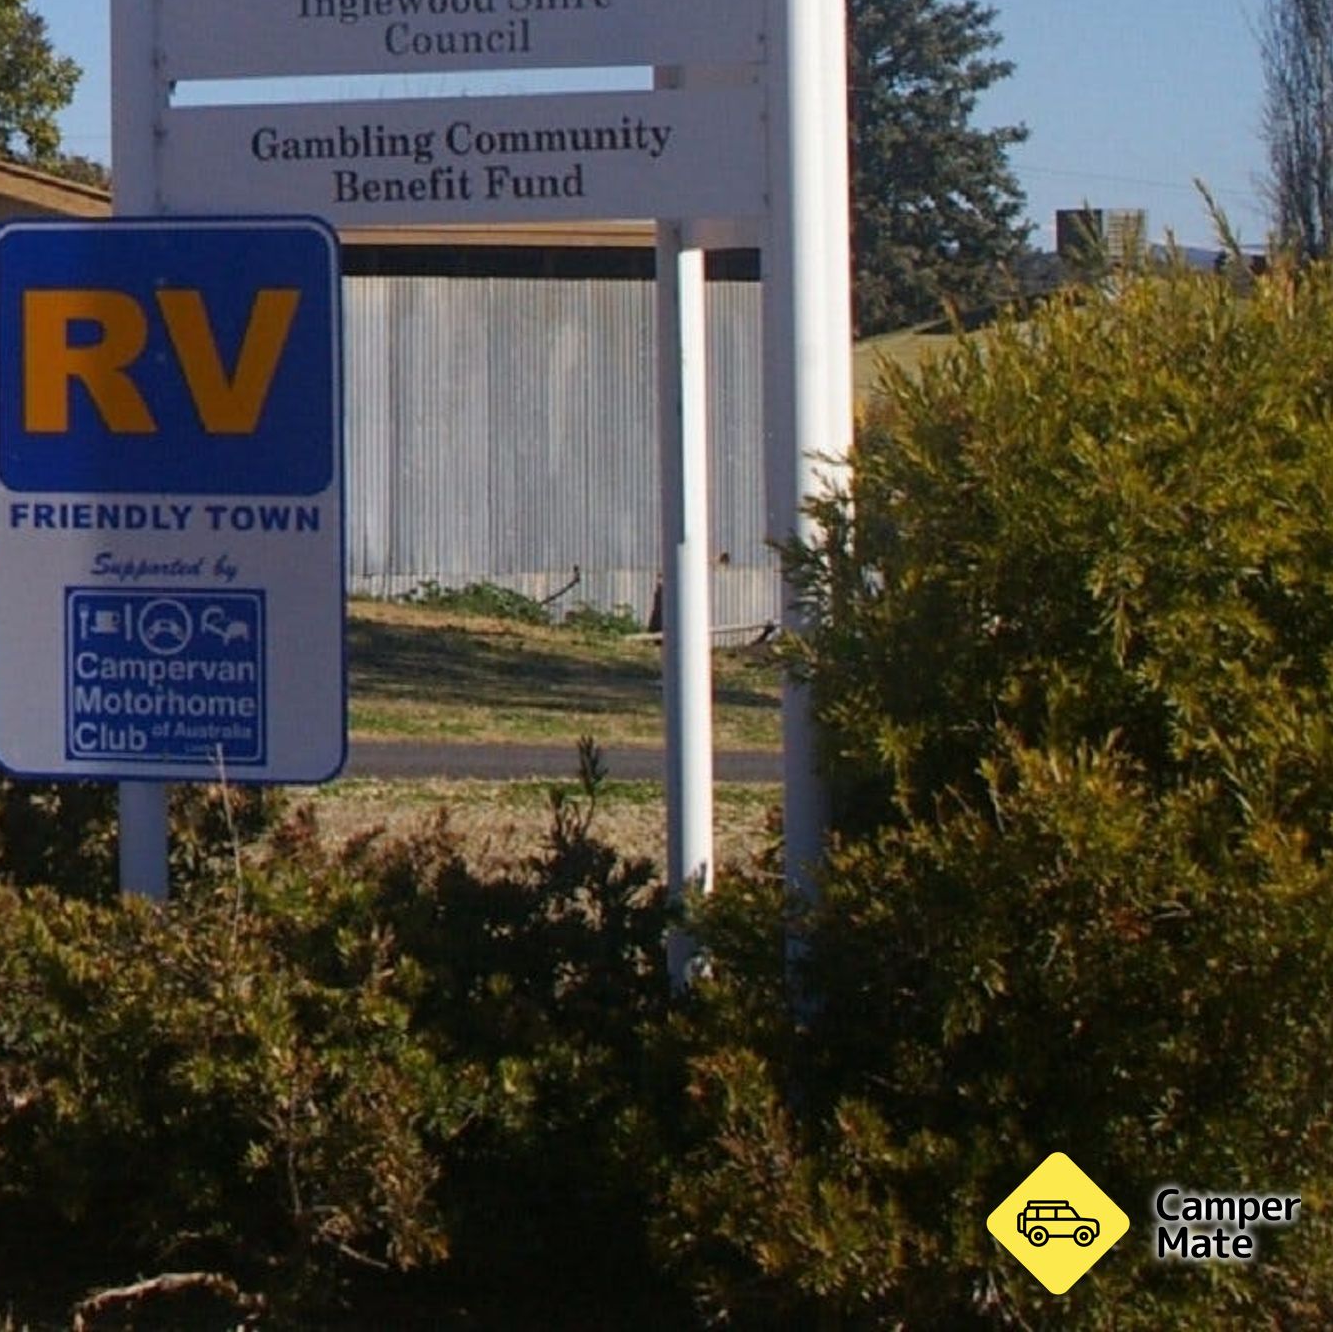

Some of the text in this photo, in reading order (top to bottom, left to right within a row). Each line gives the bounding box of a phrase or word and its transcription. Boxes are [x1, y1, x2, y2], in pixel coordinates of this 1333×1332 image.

[384, 20, 532, 56] Council
[252, 117, 672, 166] Gambling Community
[334, 164, 584, 205] Benefit Fund
[22, 288, 301, 435] RV
[10, 504, 319, 532] FRIENDLY TOWN
[90, 553, 238, 581] Supported by
[76, 652, 254, 687] Campervan
[75, 686, 256, 716] Motorhome
[75, 722, 252, 751] Club of Australia
